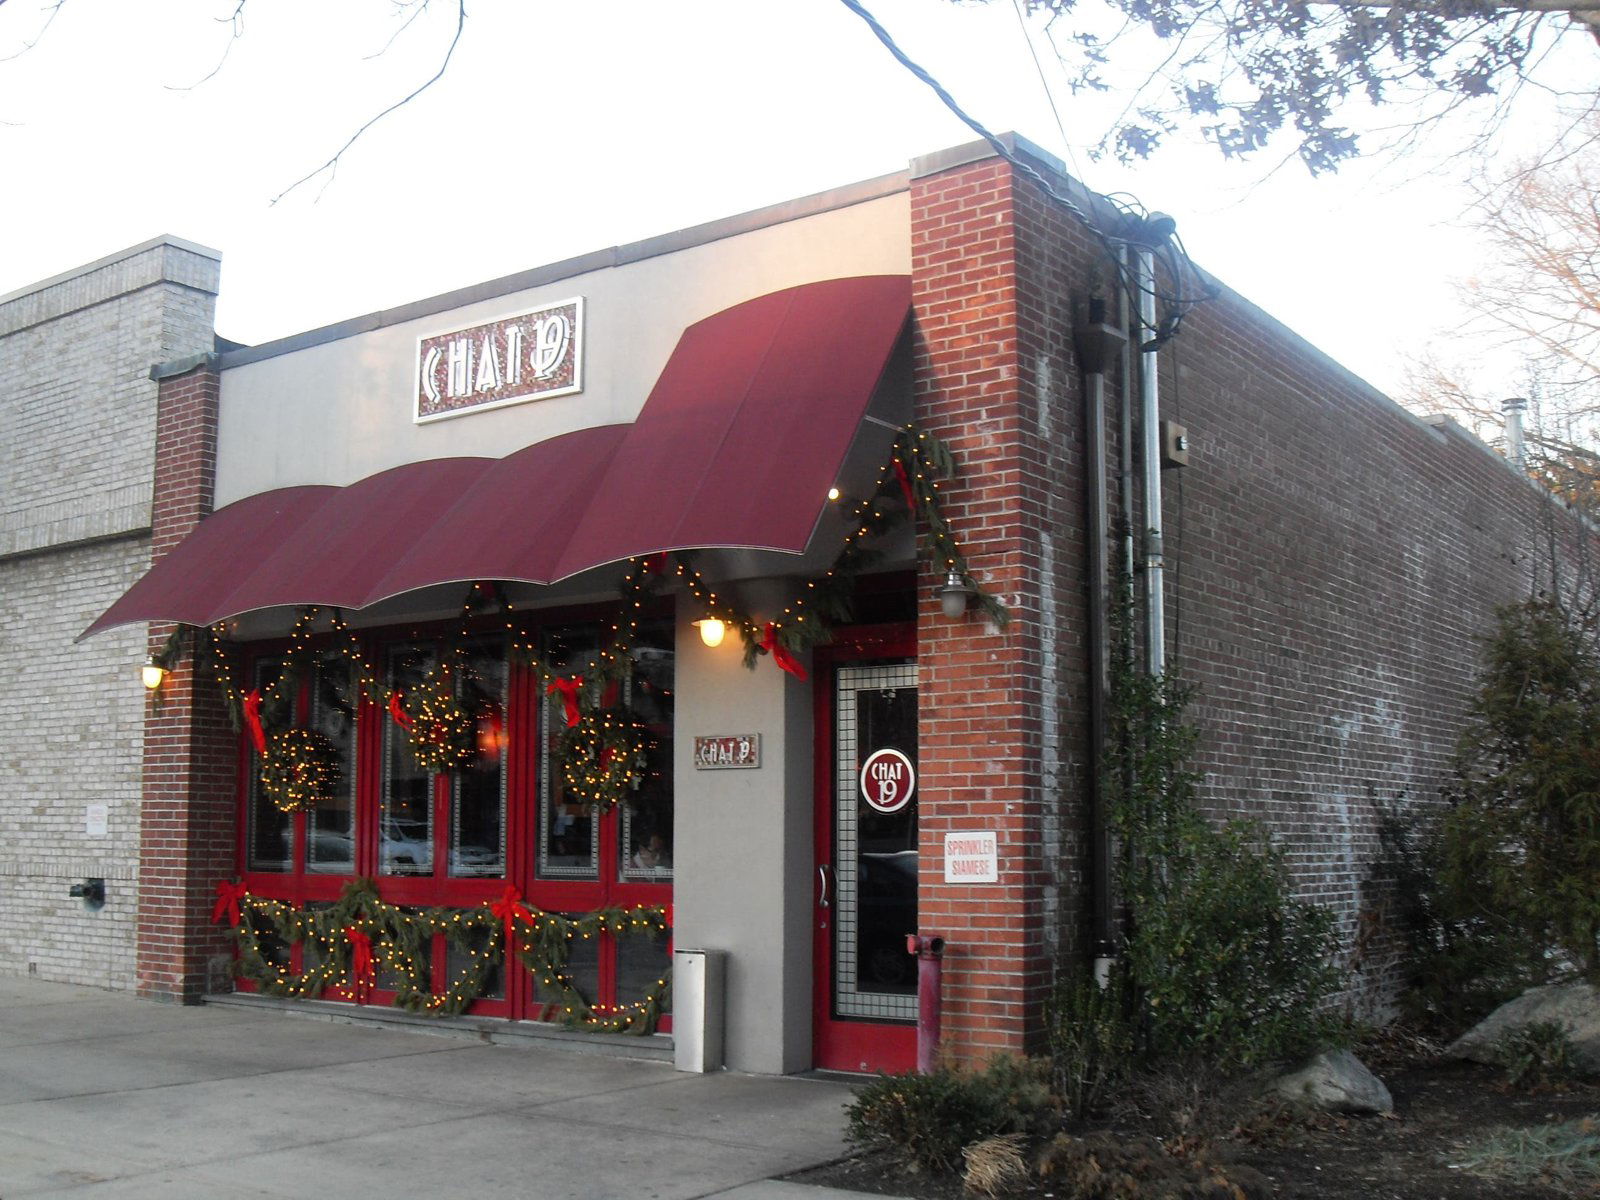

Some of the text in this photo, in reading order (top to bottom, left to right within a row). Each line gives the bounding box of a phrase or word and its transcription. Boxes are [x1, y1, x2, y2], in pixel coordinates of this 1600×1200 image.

[421, 314, 572, 404] CHAT 19
[701, 741, 734, 762] CHAT
[871, 762, 903, 780] CHAT
[877, 779, 898, 805] 19
[947, 839, 994, 856] SPRINKLER
[952, 860, 990, 876] SIAMESE
